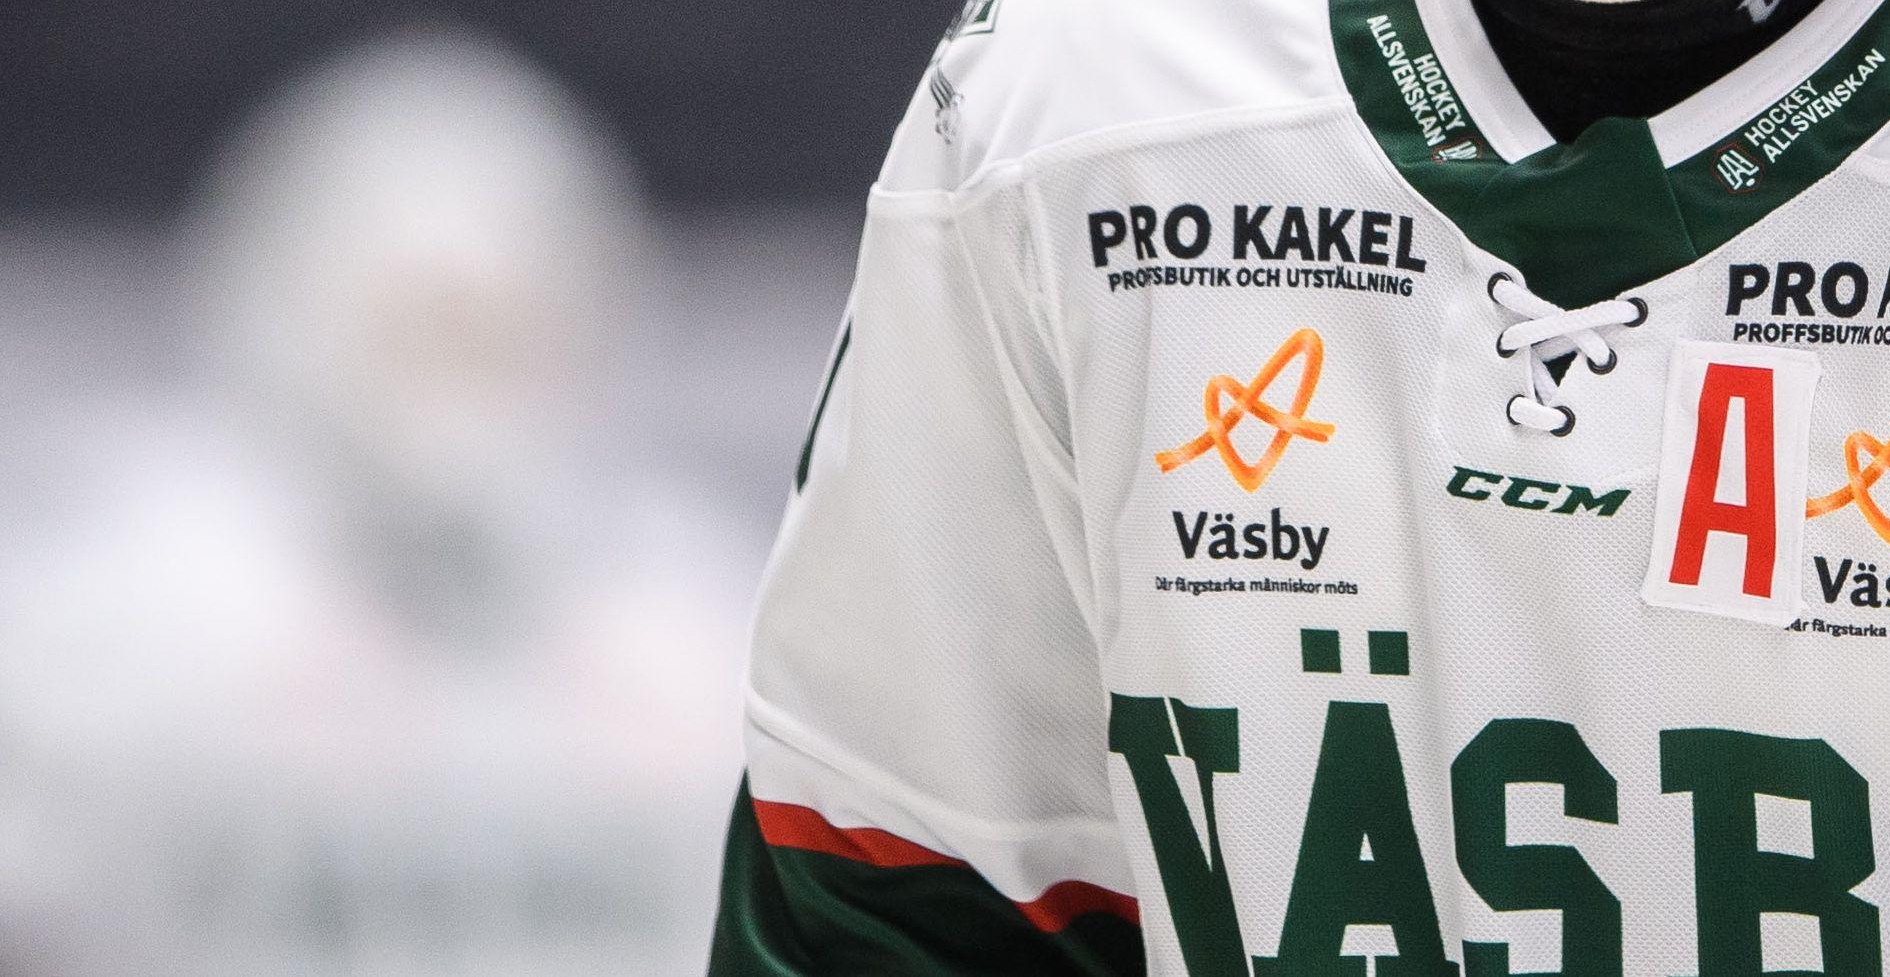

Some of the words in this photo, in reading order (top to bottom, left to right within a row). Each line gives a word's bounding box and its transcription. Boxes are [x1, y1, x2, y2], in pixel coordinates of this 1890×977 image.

[1366, 14, 1447, 148] ALLSVENSKAN
[1412, 53, 1466, 131] HOCKEY
[1762, 48, 1887, 164] ALLSVENSKAN
[1744, 79, 1819, 147] HOCKEY
[1088, 204, 1212, 268] PRO
[1233, 204, 1427, 273] KAKEL
[1236, 267, 1280, 288] OCH
[1286, 265, 1414, 297] UTSTÄLLNING
[1725, 261, 1869, 318] PRO
[1733, 323, 1873, 345] PROFFSBUTIK
[1446, 465, 1632, 518] CCM
[1668, 362, 1777, 600] A
[1172, 507, 1330, 570] Väsby
[1175, 576, 1246, 596] färgstarka
[1250, 577, 1322, 594] människor
[1324, 578, 1358, 595] möts
[1811, 618, 1887, 638] färgstarka
